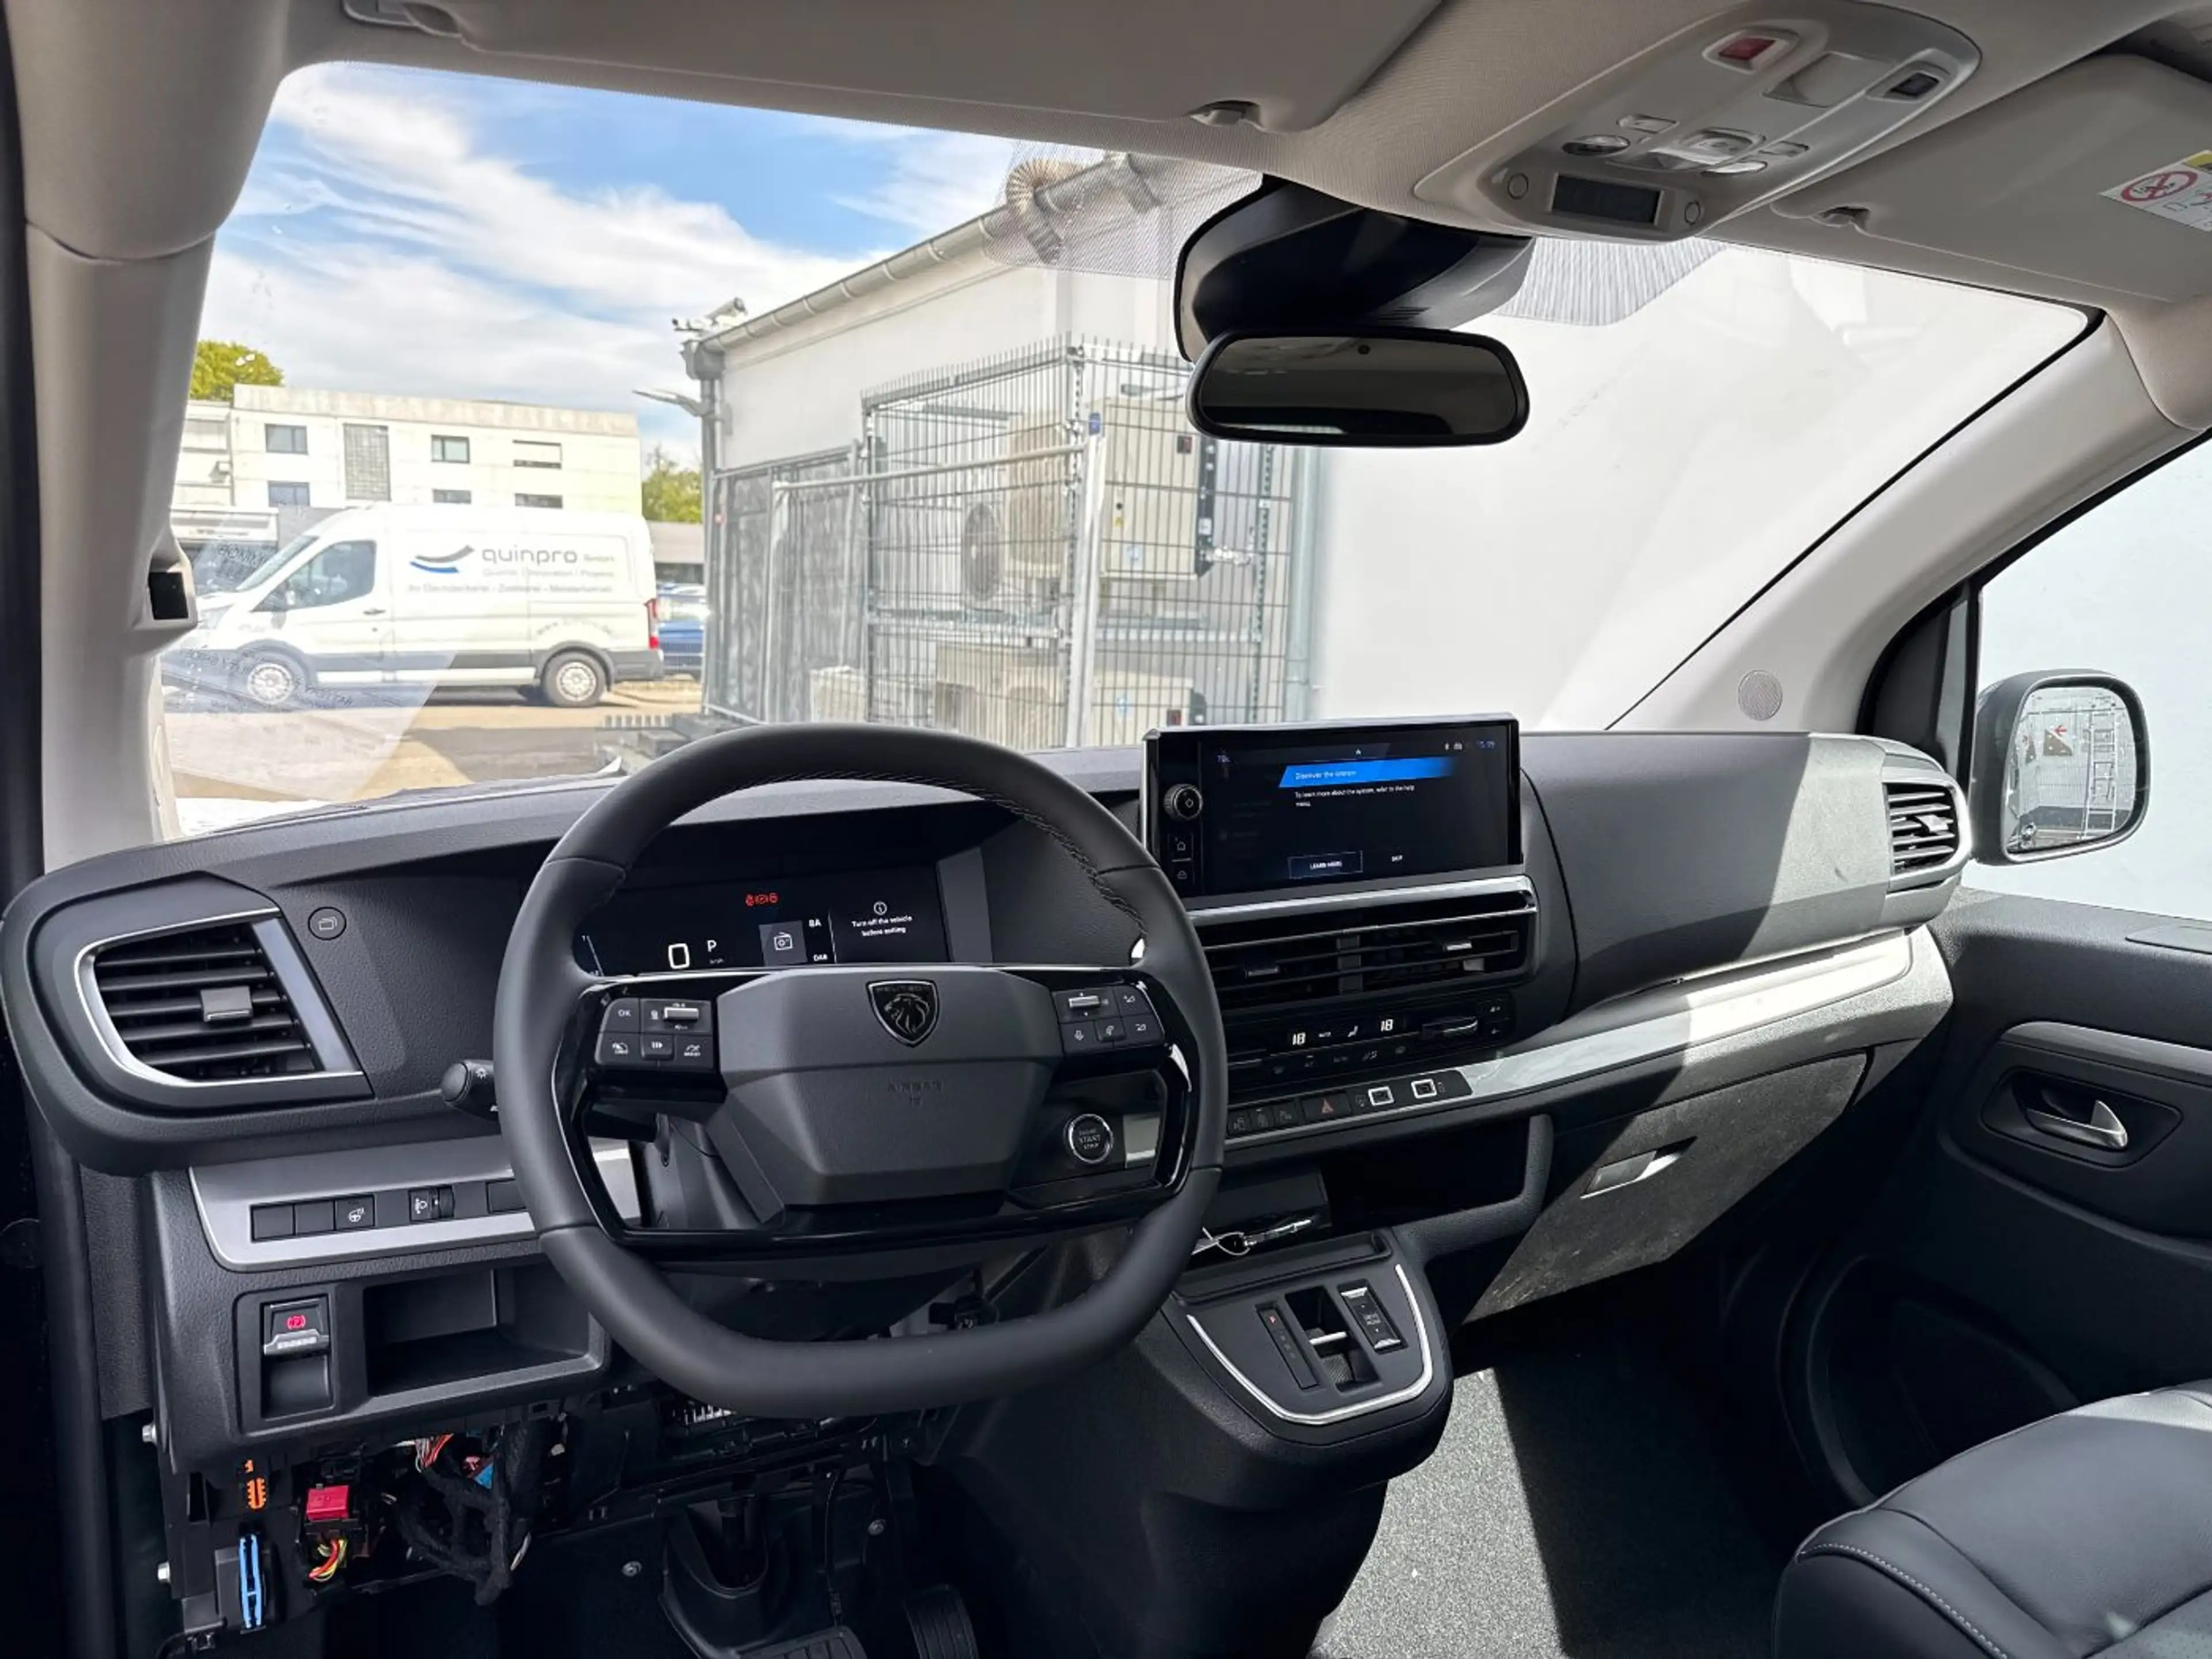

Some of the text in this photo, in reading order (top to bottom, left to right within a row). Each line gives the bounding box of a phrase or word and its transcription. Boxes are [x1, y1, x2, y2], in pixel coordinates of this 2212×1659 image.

[482, 544, 578, 566] quinpro
[1296, 772, 1321, 780] Discover
[889, 915, 912, 923] vehicle
[707, 940, 717, 952] P
[668, 943, 690, 969] 0
[813, 953, 828, 961] DAB
[1381, 1019, 1393, 1032] 18
[1292, 1032, 1306, 1046] 18
